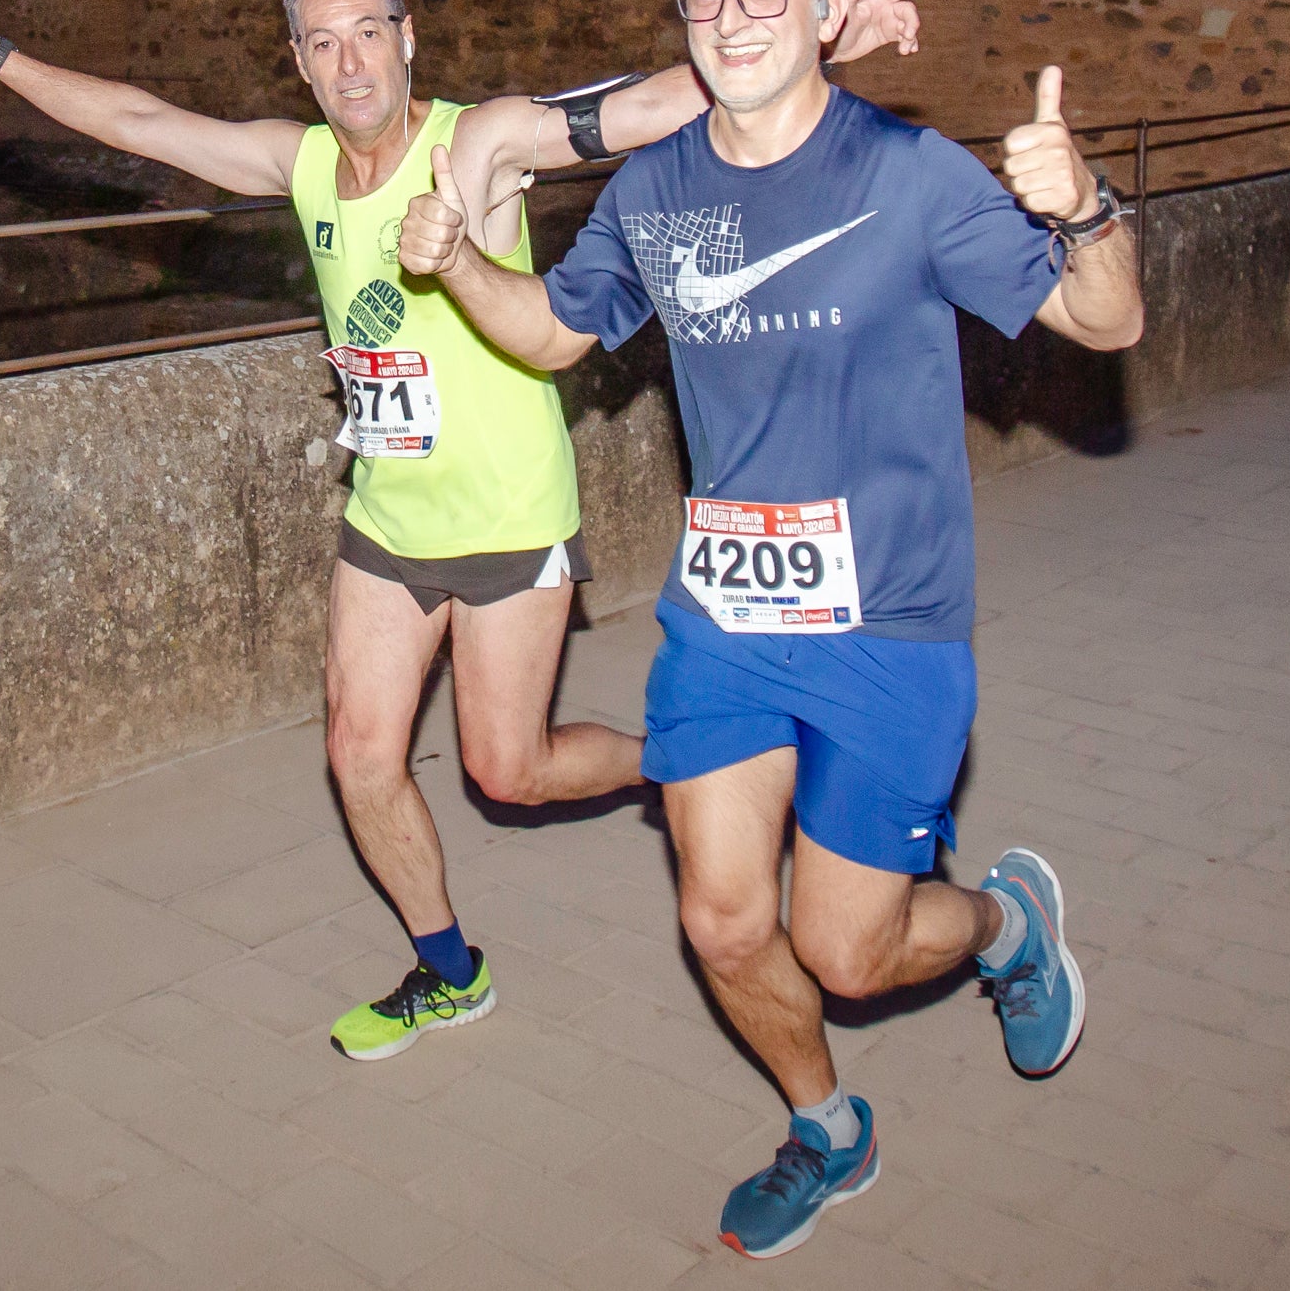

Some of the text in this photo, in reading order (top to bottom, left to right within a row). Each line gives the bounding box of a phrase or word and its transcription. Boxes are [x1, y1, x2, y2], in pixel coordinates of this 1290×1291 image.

[721, 307, 841, 336] RUNNING
[382, 366, 397, 376] MAYO
[397, 365, 413, 376] 2024
[345, 378, 414, 421] 671
[693, 502, 712, 529] 40
[776, 522, 782, 534] 4
[782, 522, 803, 534] MAYO
[803, 520, 824, 533] 2024
[688, 537, 824, 590] 4209
